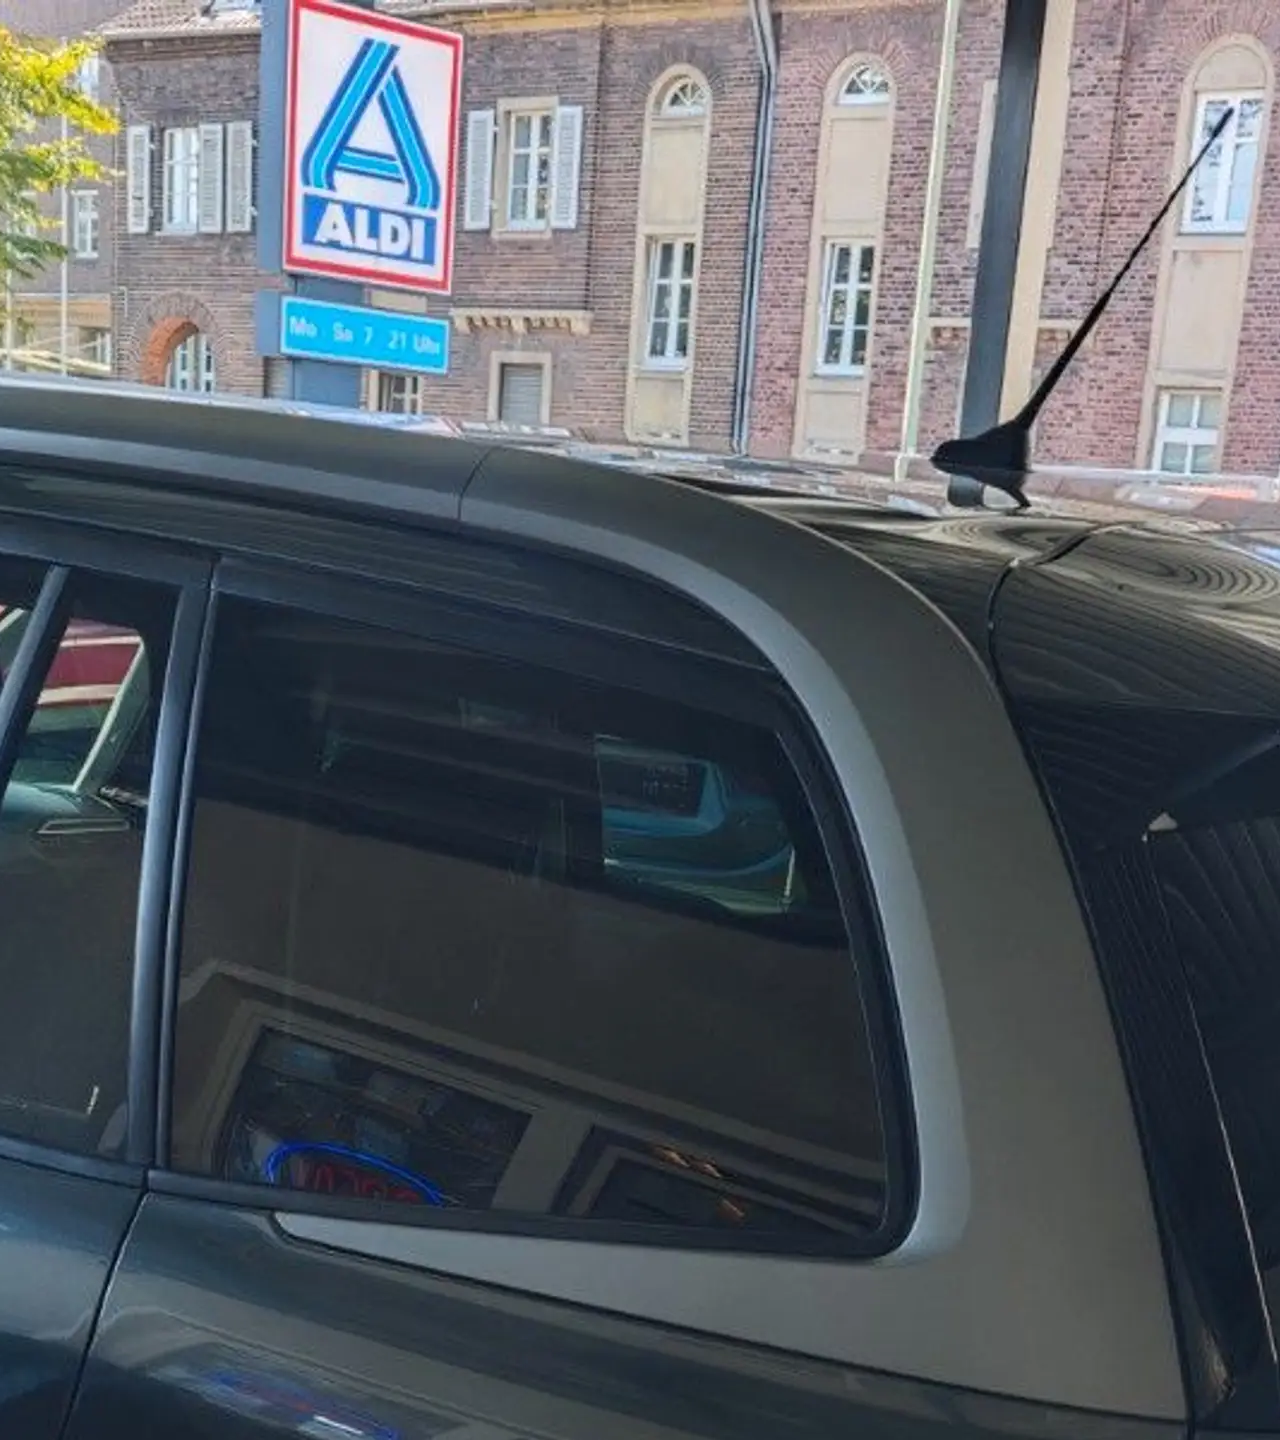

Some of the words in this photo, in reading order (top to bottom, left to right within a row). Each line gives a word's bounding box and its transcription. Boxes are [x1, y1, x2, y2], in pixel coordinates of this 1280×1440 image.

[313, 202, 427, 259] ALDI
[289, 315, 318, 339] Mo
[332, 321, 354, 343] Sa
[363, 325, 373, 345] 7
[387, 329, 407, 351] 21
[412, 332, 441, 355] Uhr
